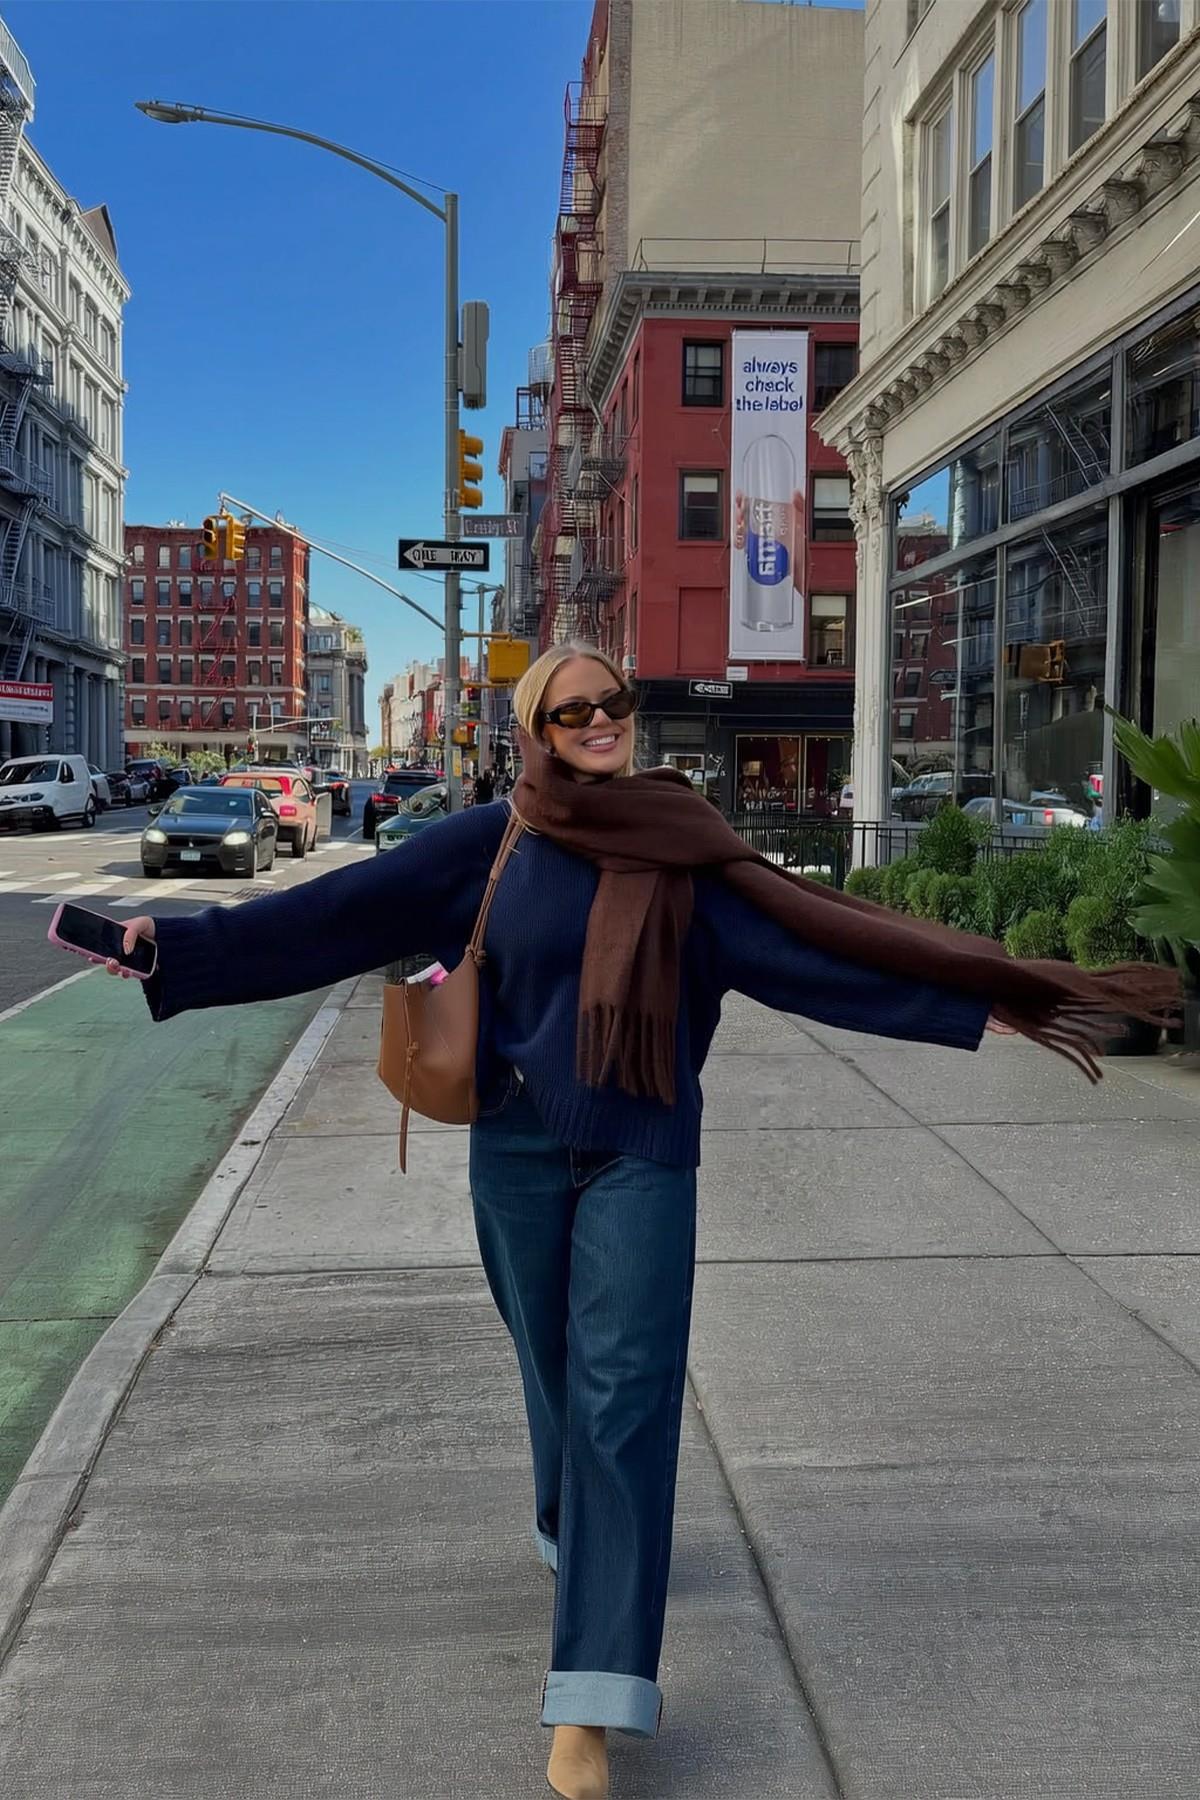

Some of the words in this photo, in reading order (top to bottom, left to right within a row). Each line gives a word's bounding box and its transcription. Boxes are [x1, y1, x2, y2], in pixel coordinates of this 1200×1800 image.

[743, 356, 798, 375] always
[745, 376, 794, 392] check
[736, 395, 763, 411] the
[765, 395, 803, 412] label
[412, 549, 437, 561] ONE
[450, 550, 477, 563] WAY
